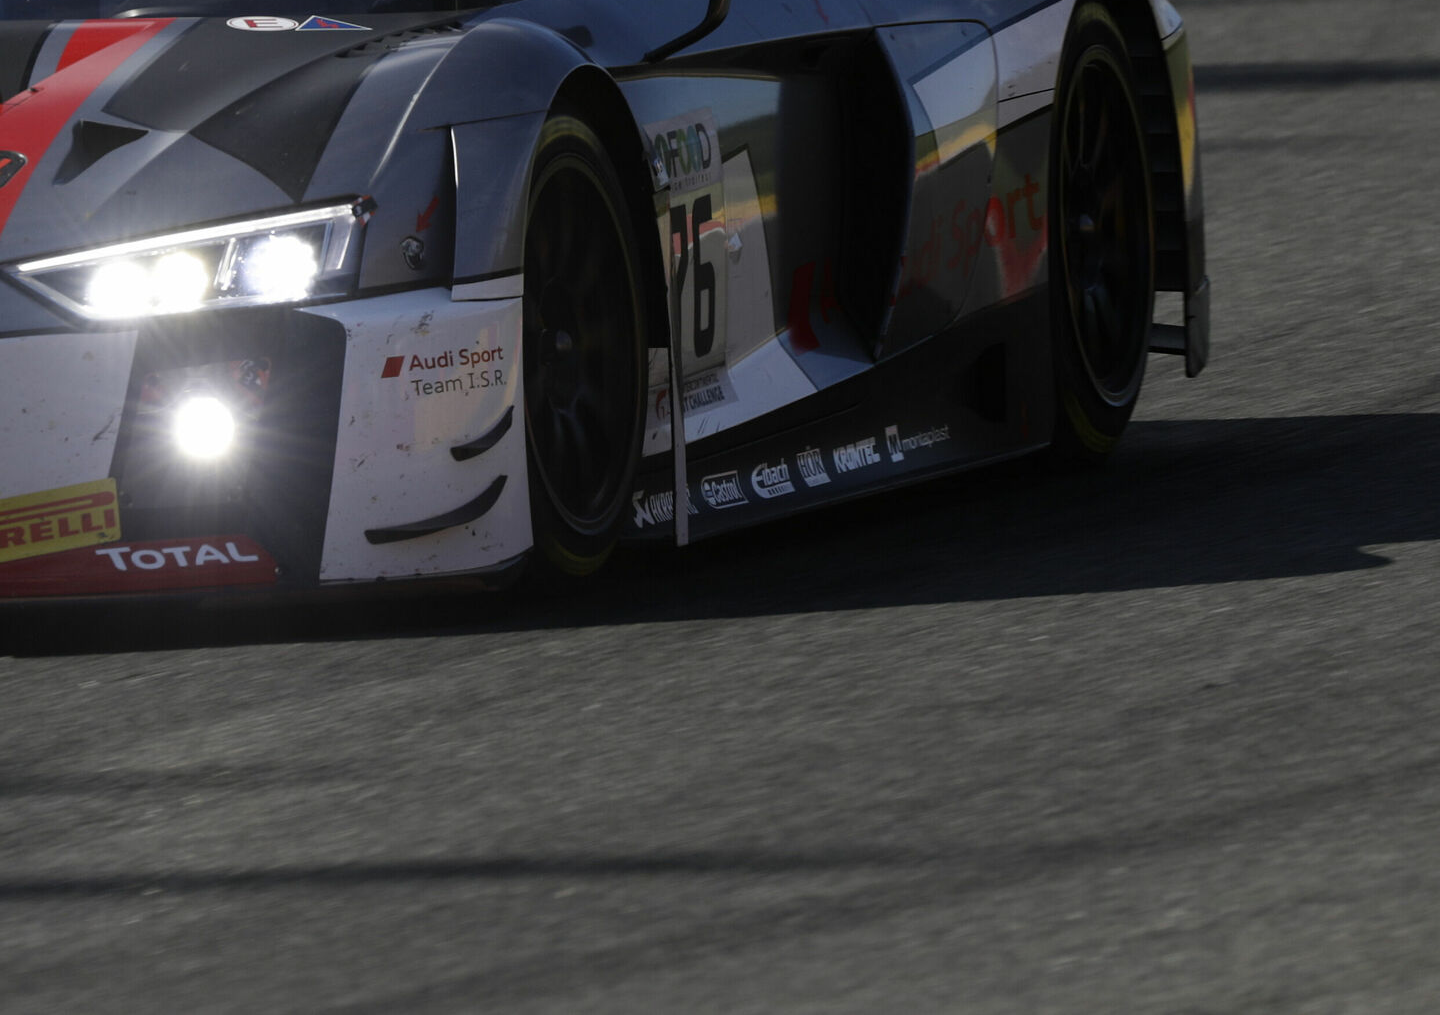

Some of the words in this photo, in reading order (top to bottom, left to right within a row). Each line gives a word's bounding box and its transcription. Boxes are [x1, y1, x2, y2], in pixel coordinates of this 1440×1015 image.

[409, 351, 454, 371] Audi
[458, 346, 505, 368] Sport
[411, 377, 463, 396] Team
[467, 369, 508, 390] I.S.R.
[710, 477, 744, 505] Castrol
[95, 542, 259, 571] TOTAL
